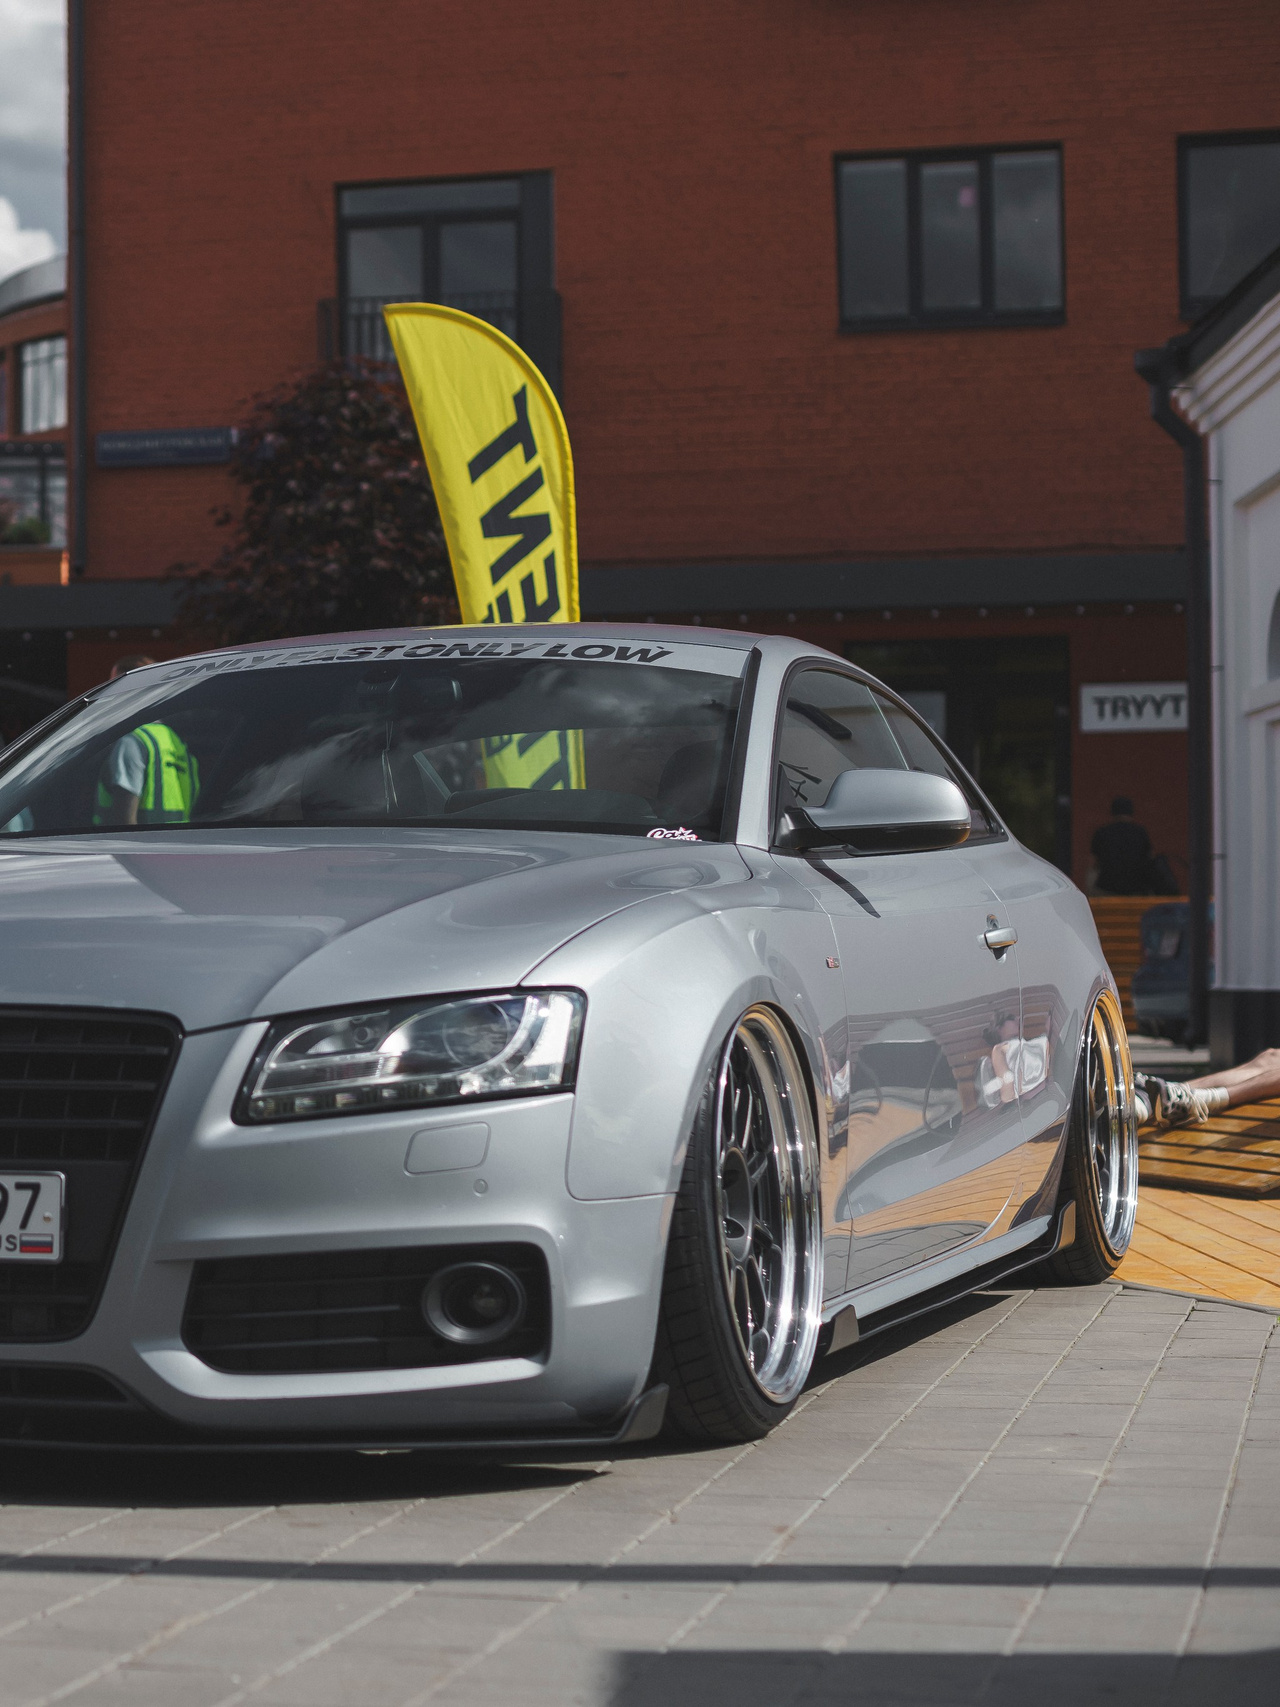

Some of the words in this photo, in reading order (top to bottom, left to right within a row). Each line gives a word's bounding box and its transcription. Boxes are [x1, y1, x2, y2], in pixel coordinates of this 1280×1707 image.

[160, 653, 285, 681] ONLY
[277, 644, 408, 666] FAST
[402, 642, 549, 659] ONLY
[541, 642, 675, 664] LOW
[1092, 693, 1186, 720] TRYYT
